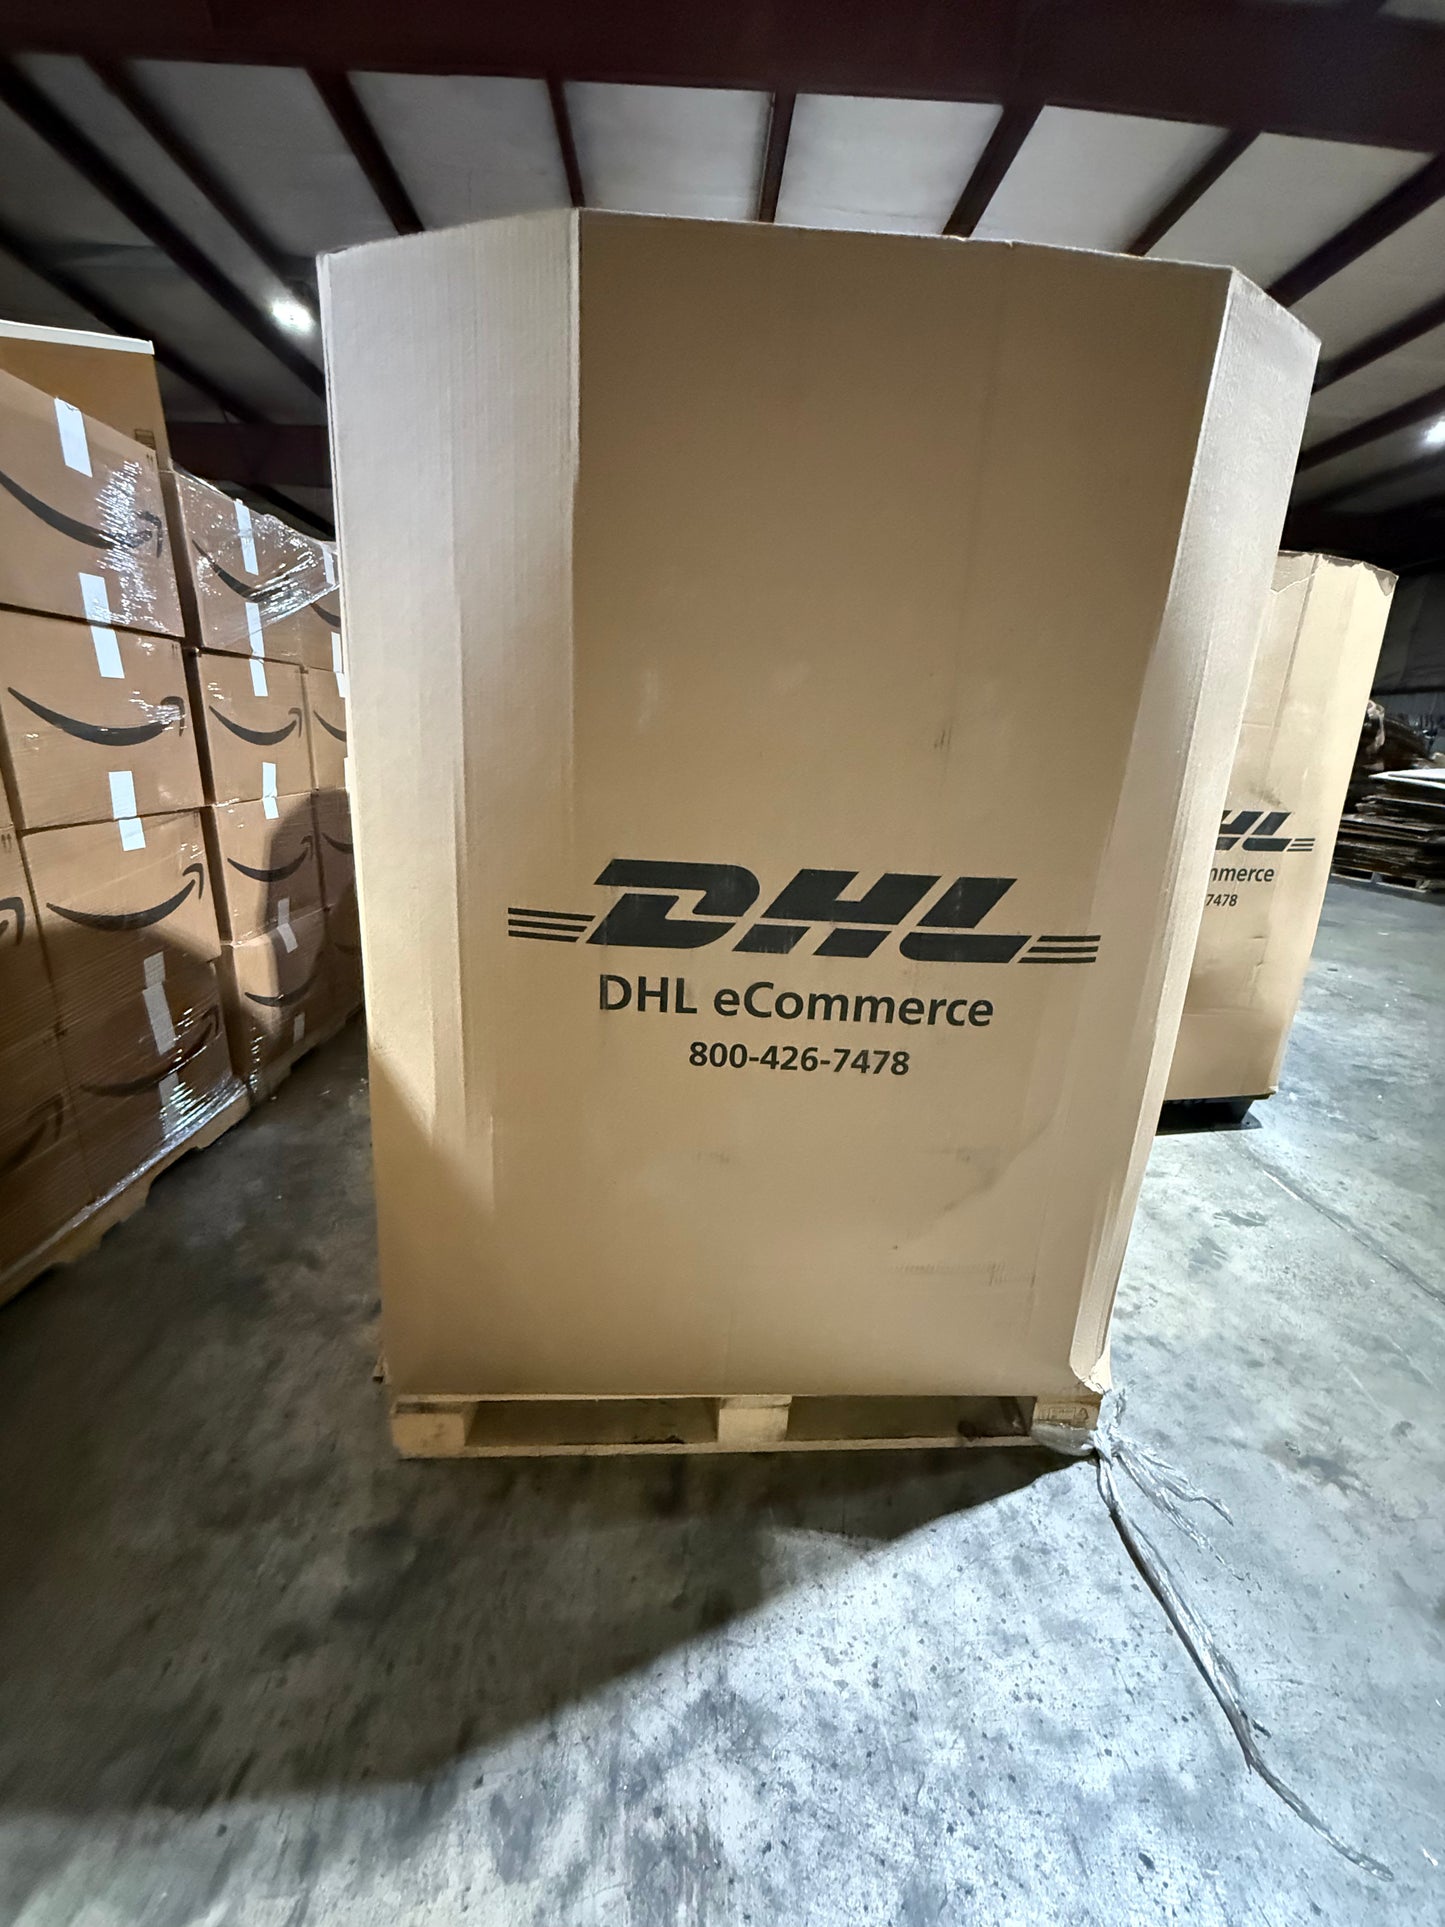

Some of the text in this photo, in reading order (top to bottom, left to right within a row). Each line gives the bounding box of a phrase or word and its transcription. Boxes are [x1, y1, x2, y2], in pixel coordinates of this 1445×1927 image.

[587, 859, 1030, 963] DHL
[599, 975, 993, 1027] DHL eCommerce
[689, 1041, 909, 1076] 800-426-7478
